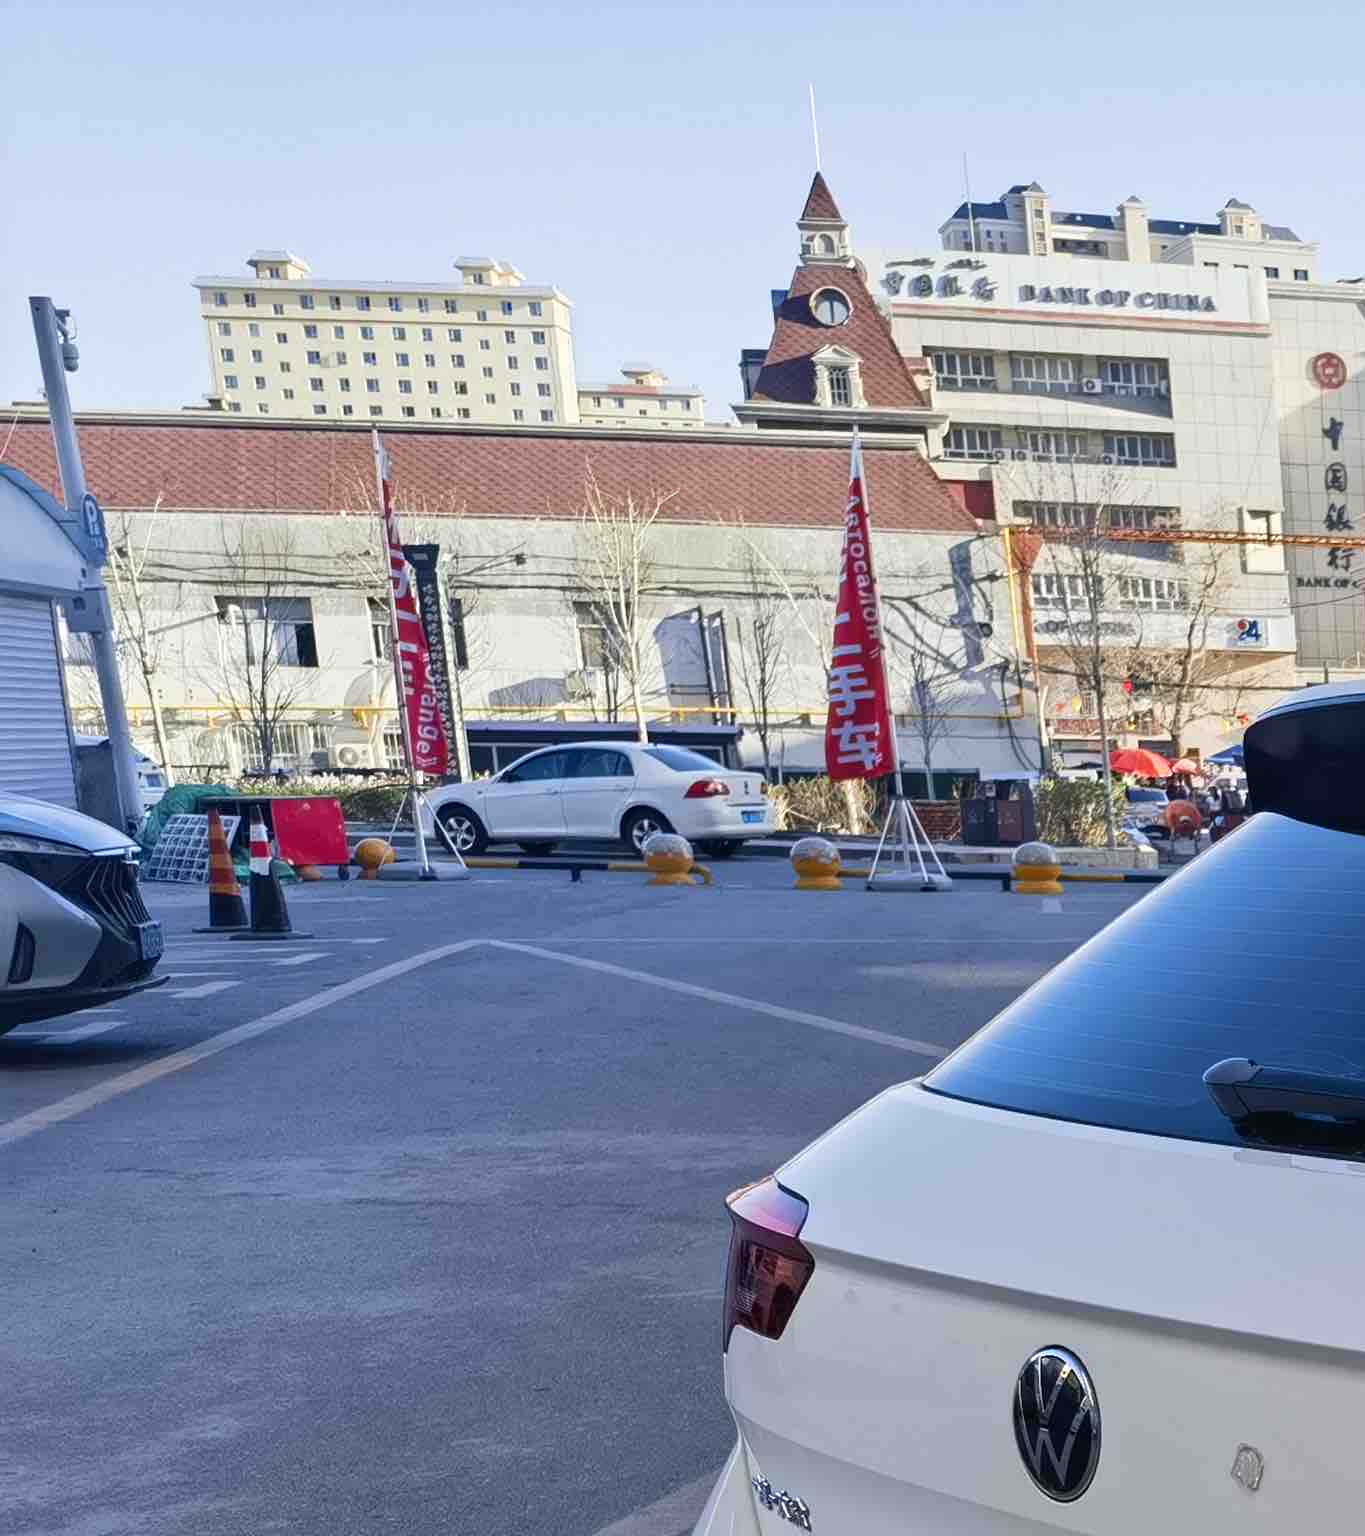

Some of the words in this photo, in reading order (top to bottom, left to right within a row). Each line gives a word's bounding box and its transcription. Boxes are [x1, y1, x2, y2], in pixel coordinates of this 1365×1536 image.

[1018, 285, 1091, 305] BANK
[1095, 289, 1131, 308] OF
[1134, 291, 1217, 313] CHINA
[1321, 416, 1355, 573] 中国银行
